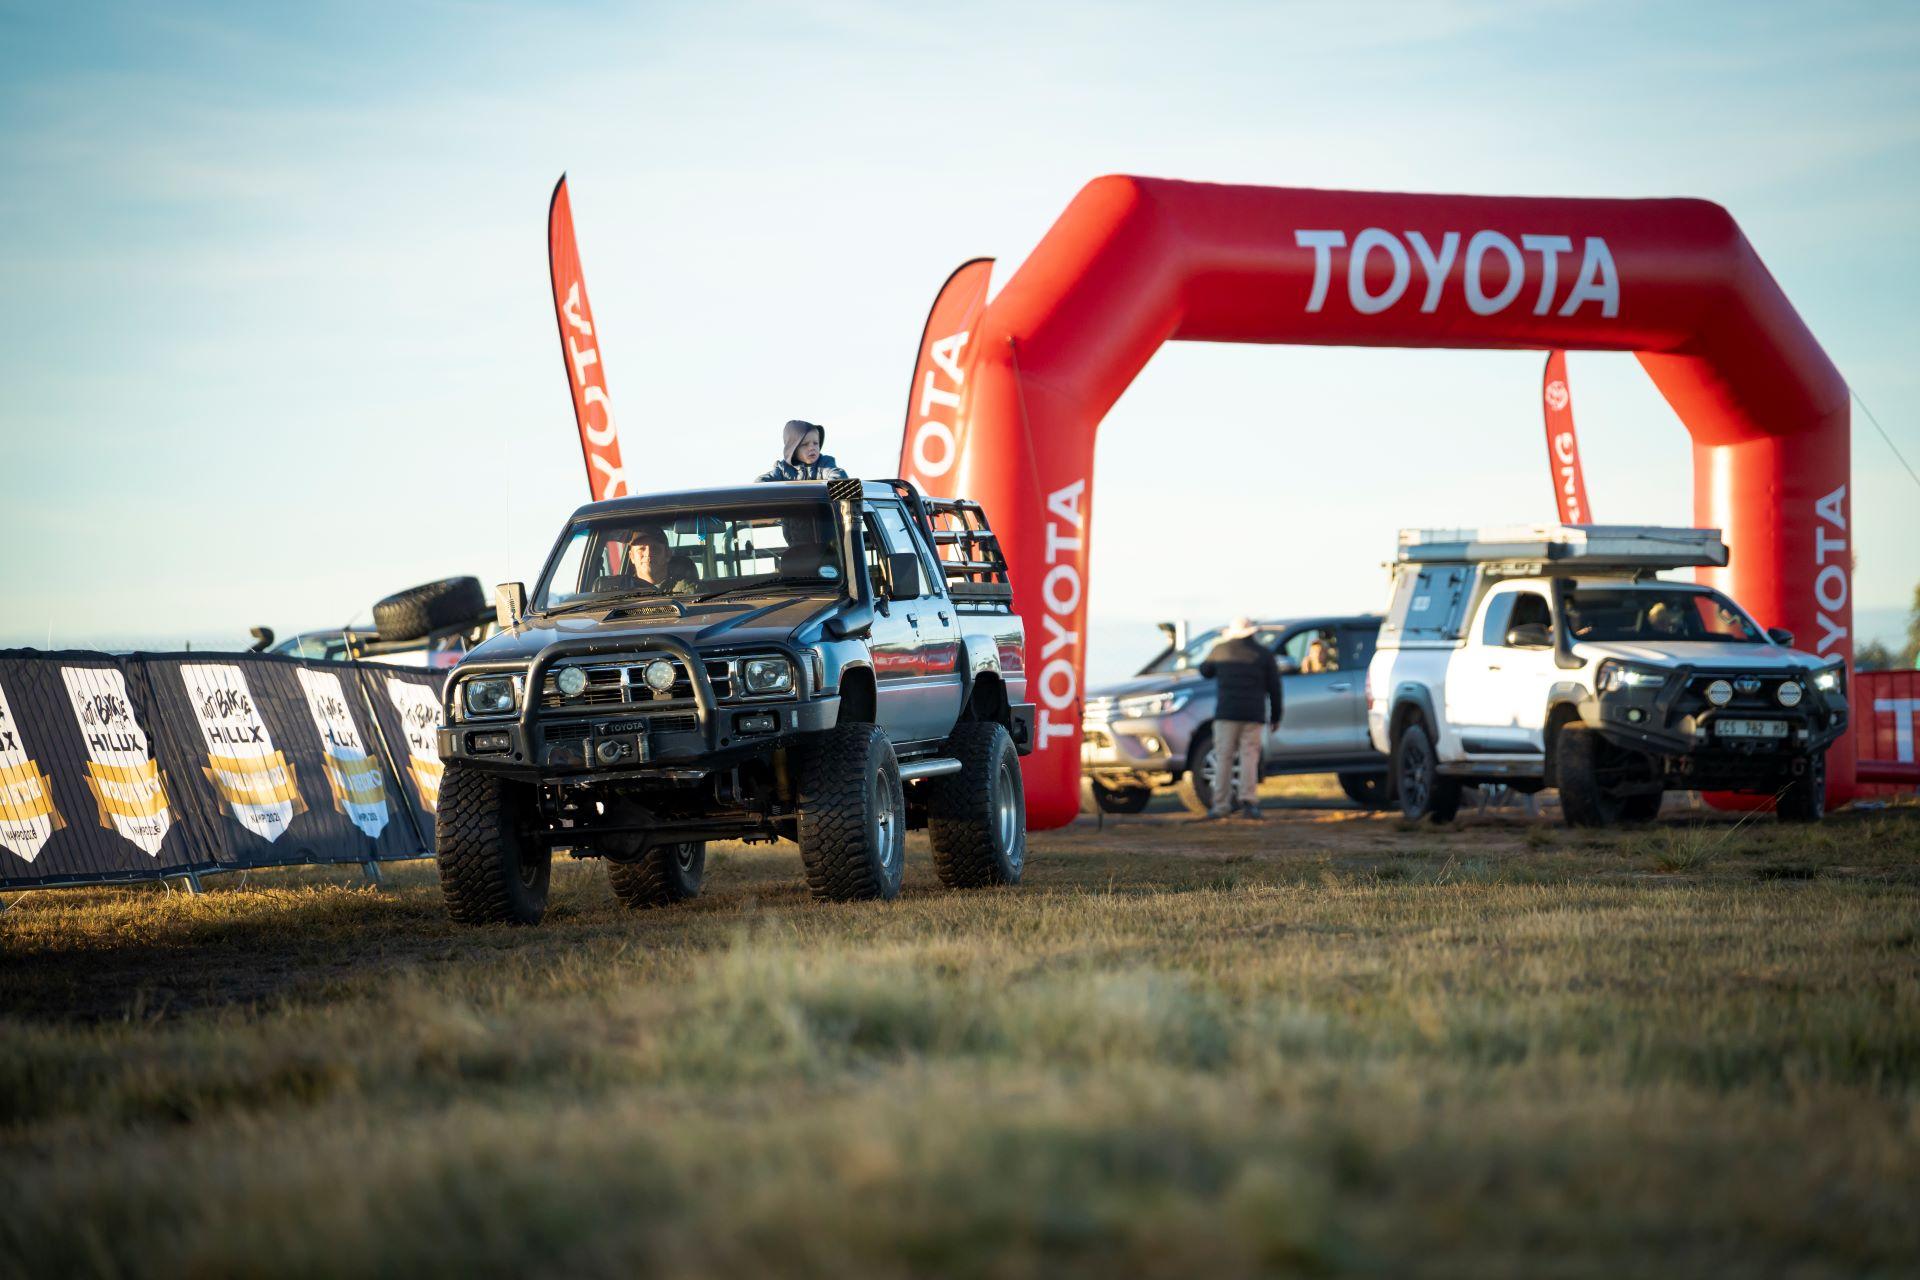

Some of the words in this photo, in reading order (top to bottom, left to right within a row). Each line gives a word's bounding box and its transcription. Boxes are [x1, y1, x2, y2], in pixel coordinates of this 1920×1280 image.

[1294, 227, 1621, 318] TOYOTA
[563, 281, 627, 500] YOTA
[908, 331, 969, 497] OTA
[1038, 479, 1086, 750] TOYOTA
[1814, 484, 1848, 665] YOTA
[88, 734, 144, 751] HILUX
[609, 722, 644, 732] TOYOTA
